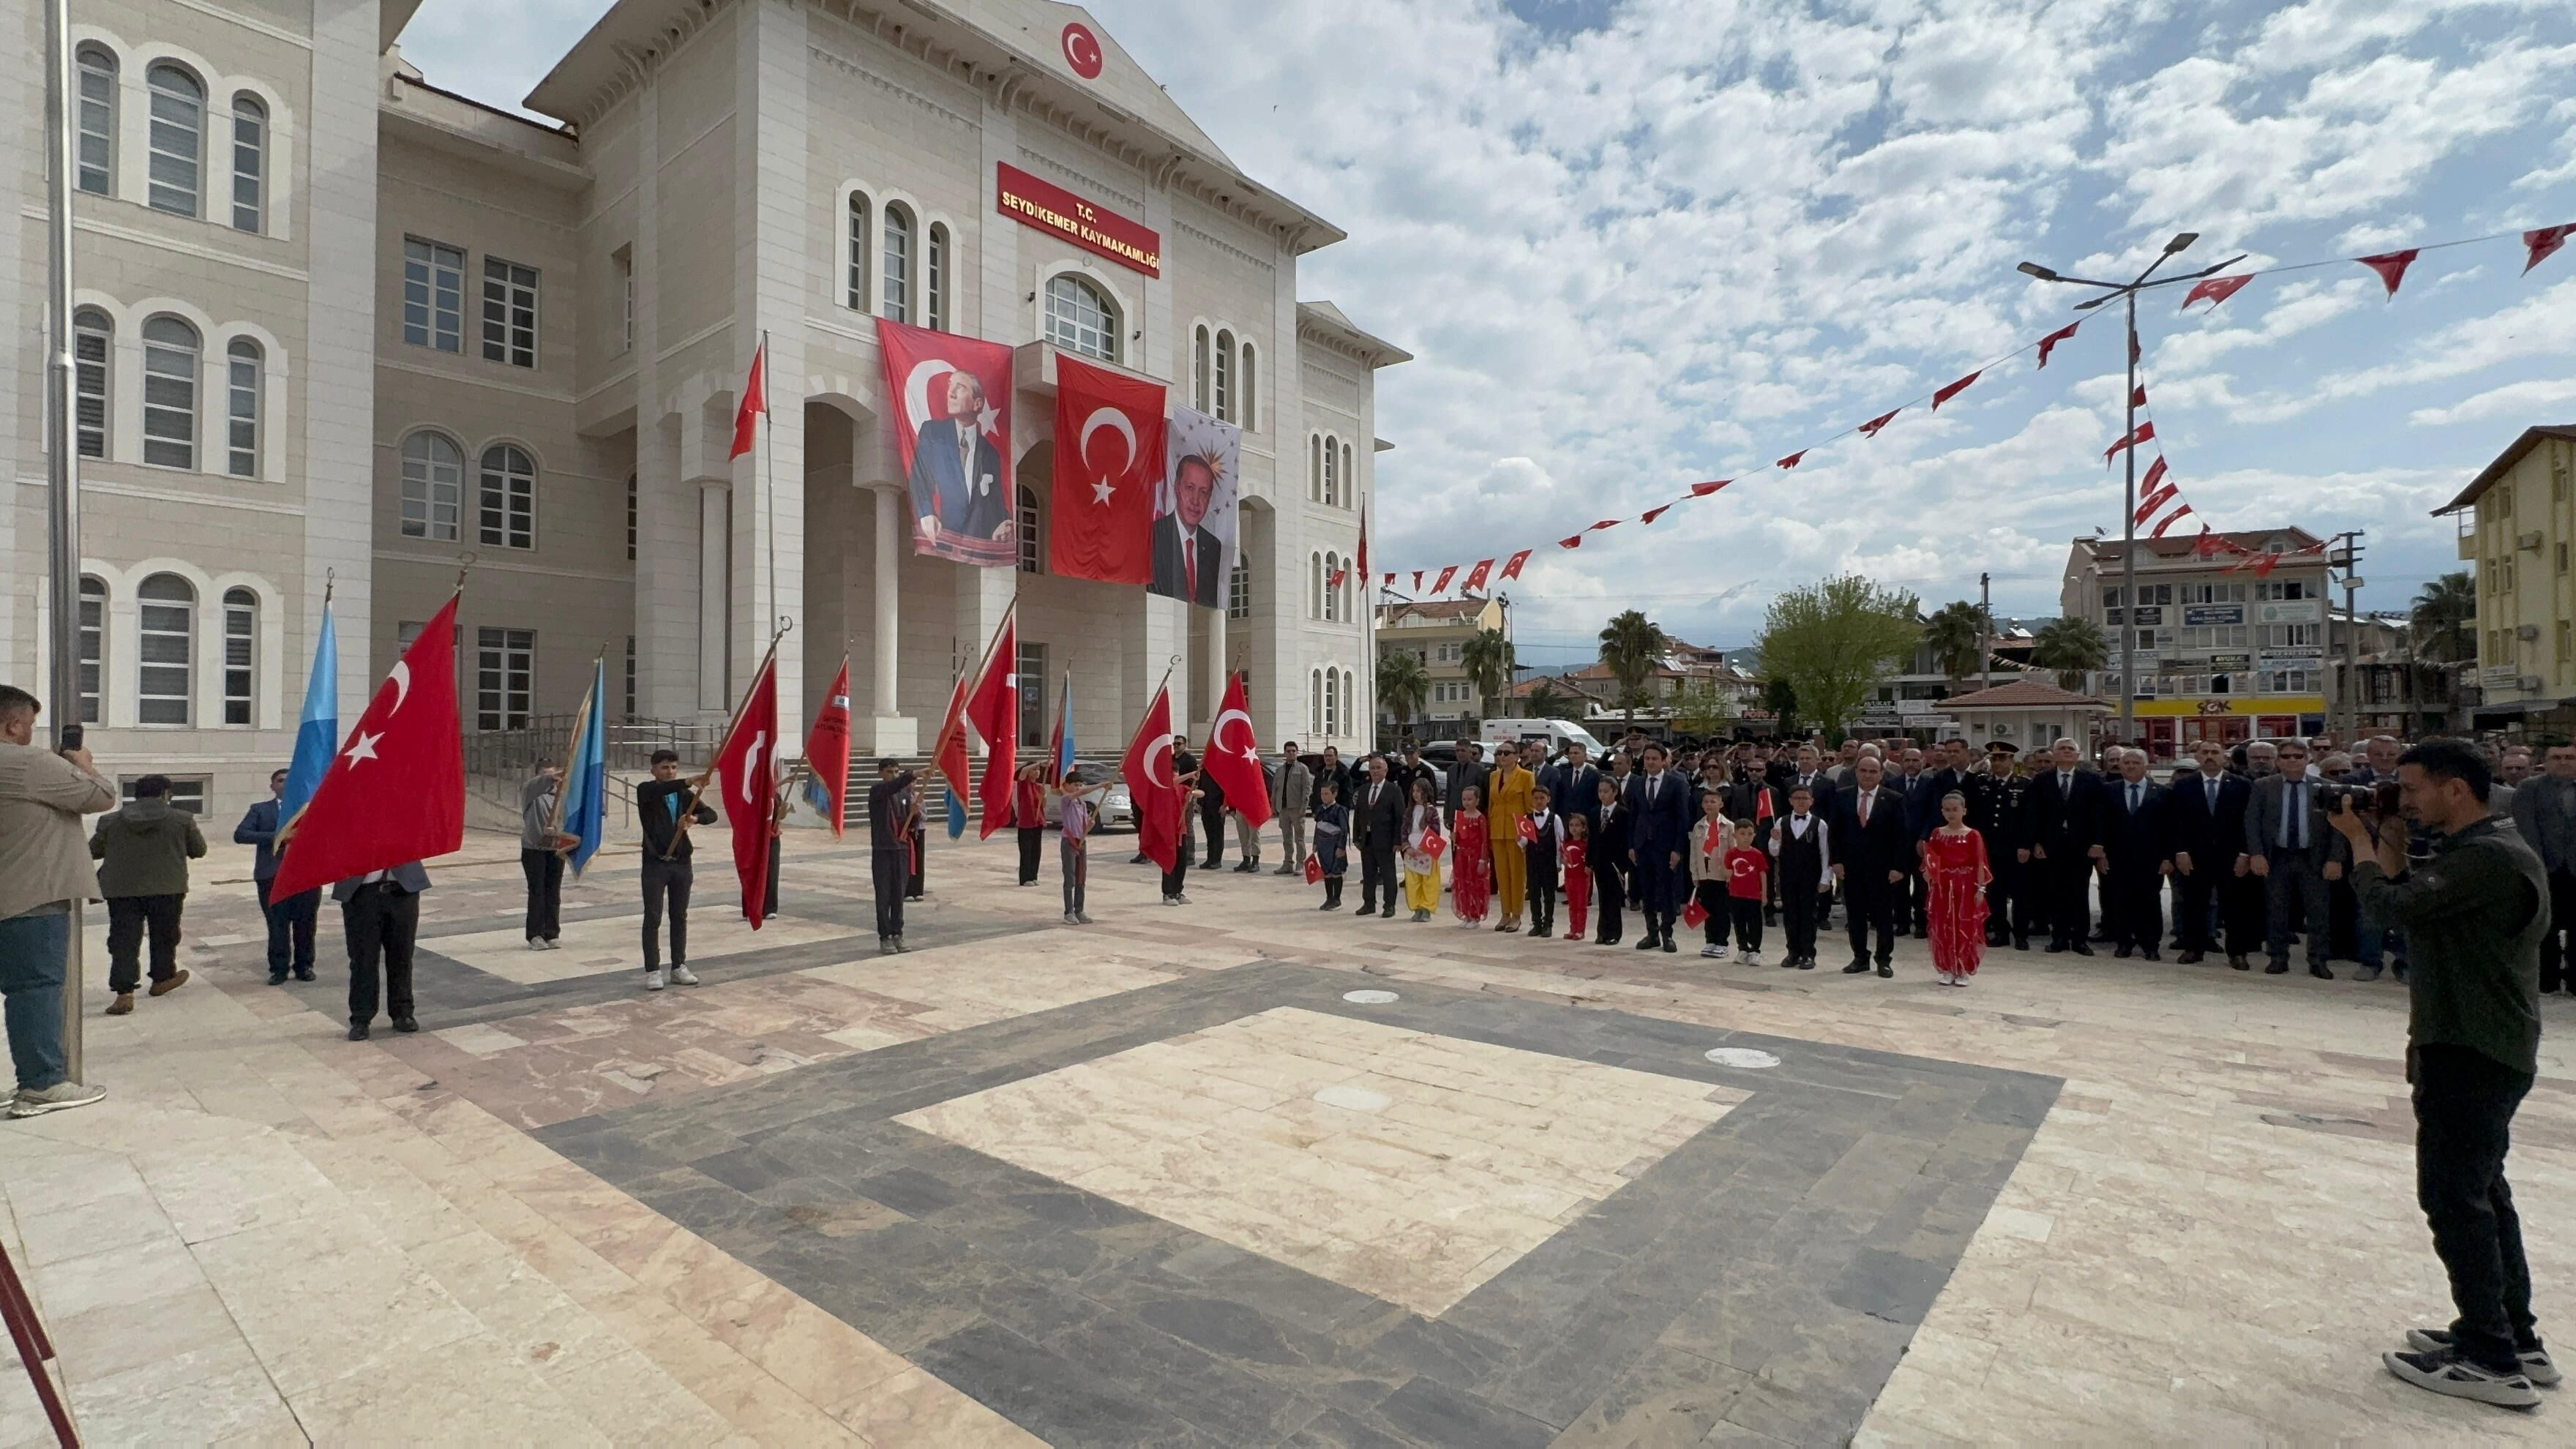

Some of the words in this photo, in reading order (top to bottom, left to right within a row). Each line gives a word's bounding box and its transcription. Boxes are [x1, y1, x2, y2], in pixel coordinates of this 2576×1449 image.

[1002, 191, 1078, 235] SEYDİKEMER
[1081, 225, 1160, 269] KAYMAKAMLIĞI
[1076, 203, 1097, 222] T.C.
